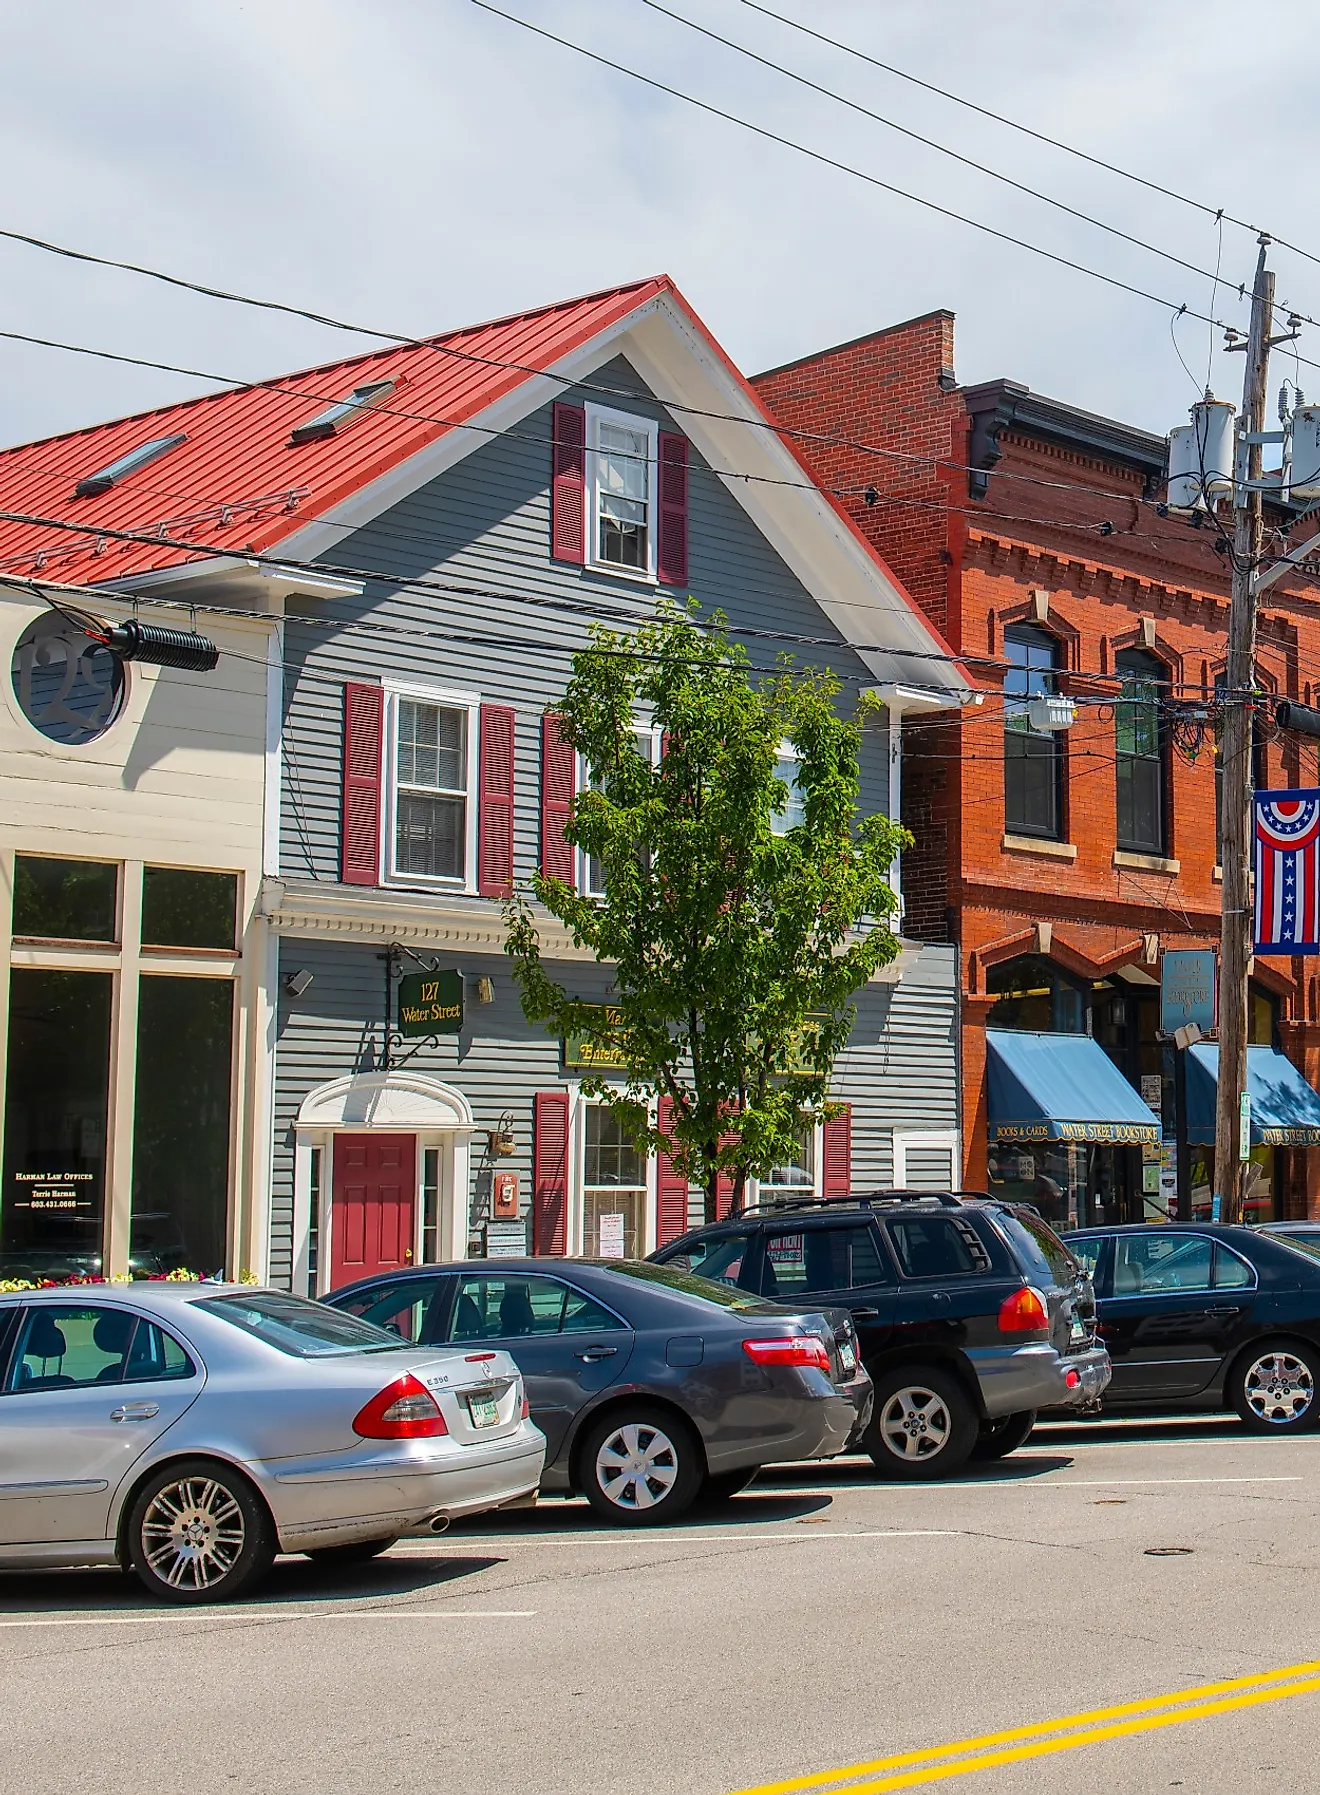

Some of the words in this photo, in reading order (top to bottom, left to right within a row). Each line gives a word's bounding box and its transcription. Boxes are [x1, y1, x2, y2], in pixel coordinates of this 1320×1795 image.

[421, 981, 440, 1002] 127
[401, 1006, 430, 1023] Water
[430, 1003, 461, 1020] Street
[996, 1125, 1018, 1137] BOOKS
[1026, 1125, 1048, 1136] CARDS
[1061, 1123, 1086, 1138] WATER
[1087, 1124, 1114, 1139] STREET
[1115, 1125, 1158, 1140] BOOKSTORE
[1285, 1129, 1307, 1142] STREET
[15, 1172, 45, 1180] HARMAN
[46, 1172, 62, 1180] LAW
[63, 1172, 93, 1180] OFFICES
[31, 1190, 51, 1198] Terrie
[51, 1190, 76, 1198] Harman
